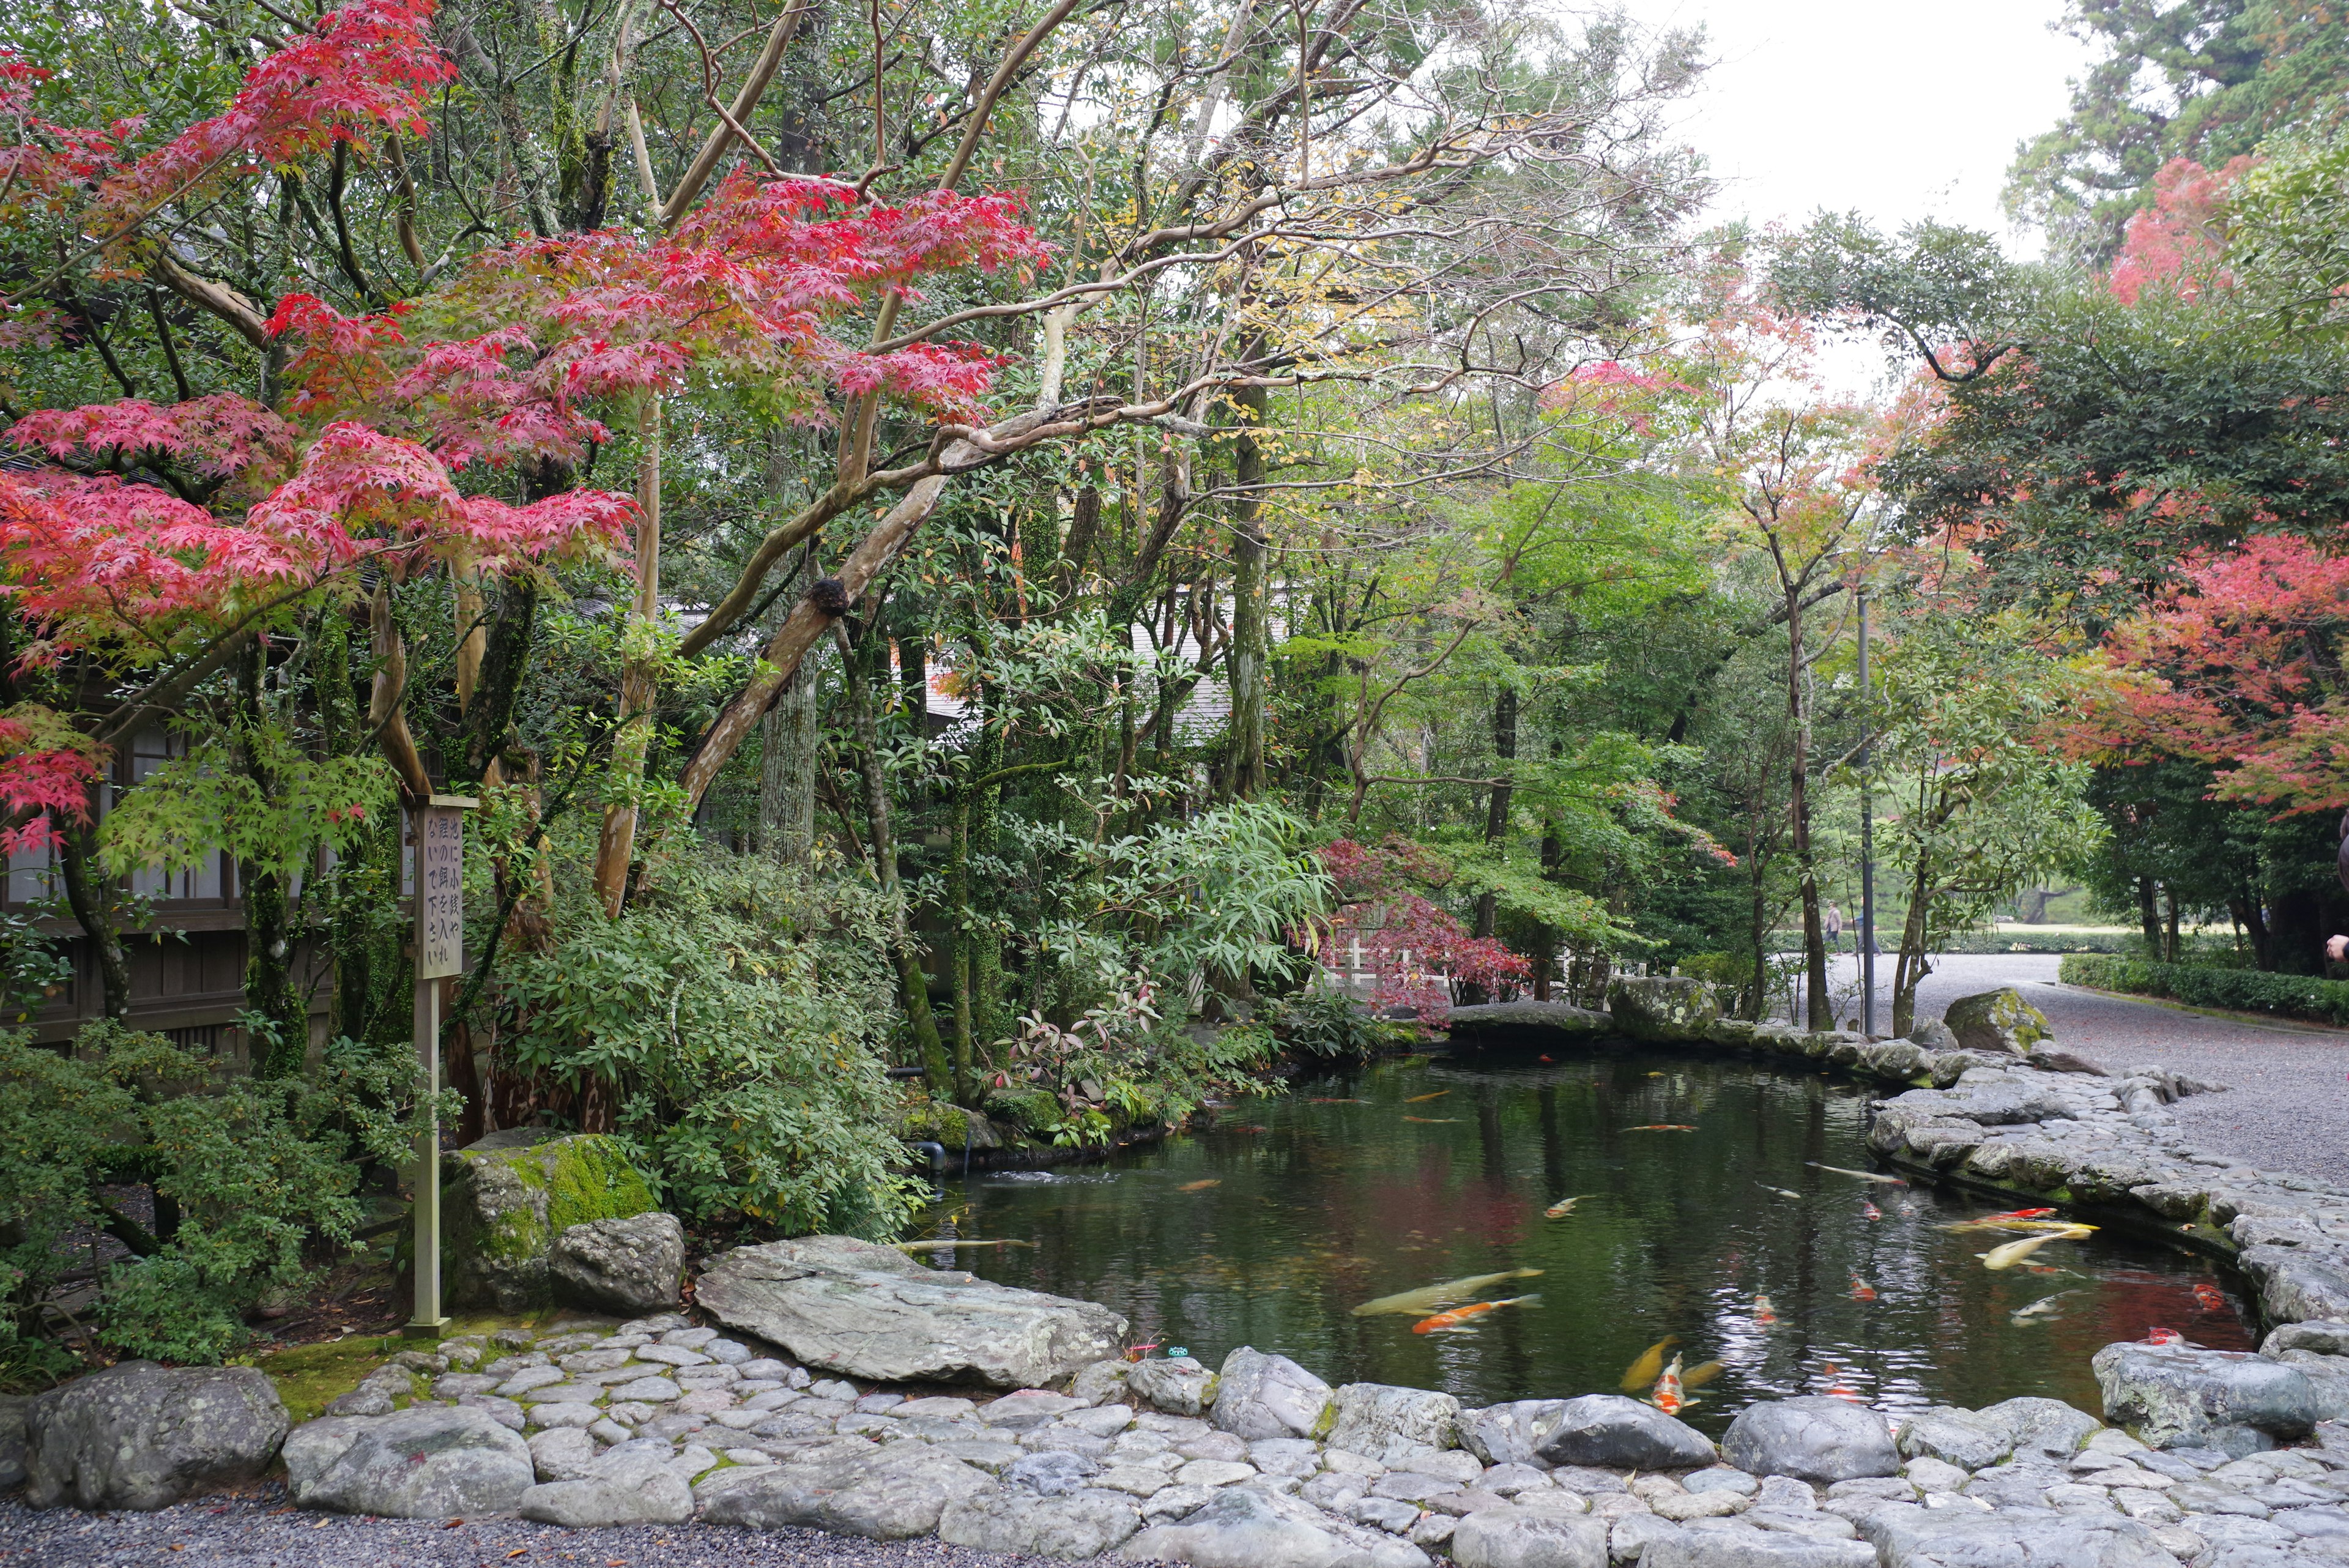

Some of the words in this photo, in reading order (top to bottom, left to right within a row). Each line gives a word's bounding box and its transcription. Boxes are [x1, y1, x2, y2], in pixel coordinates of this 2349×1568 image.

[428, 817, 437, 966] ないで下さい
[439, 817, 448, 965] 鯉の餌を入れ
[450, 817, 459, 939] 池に小銭や
